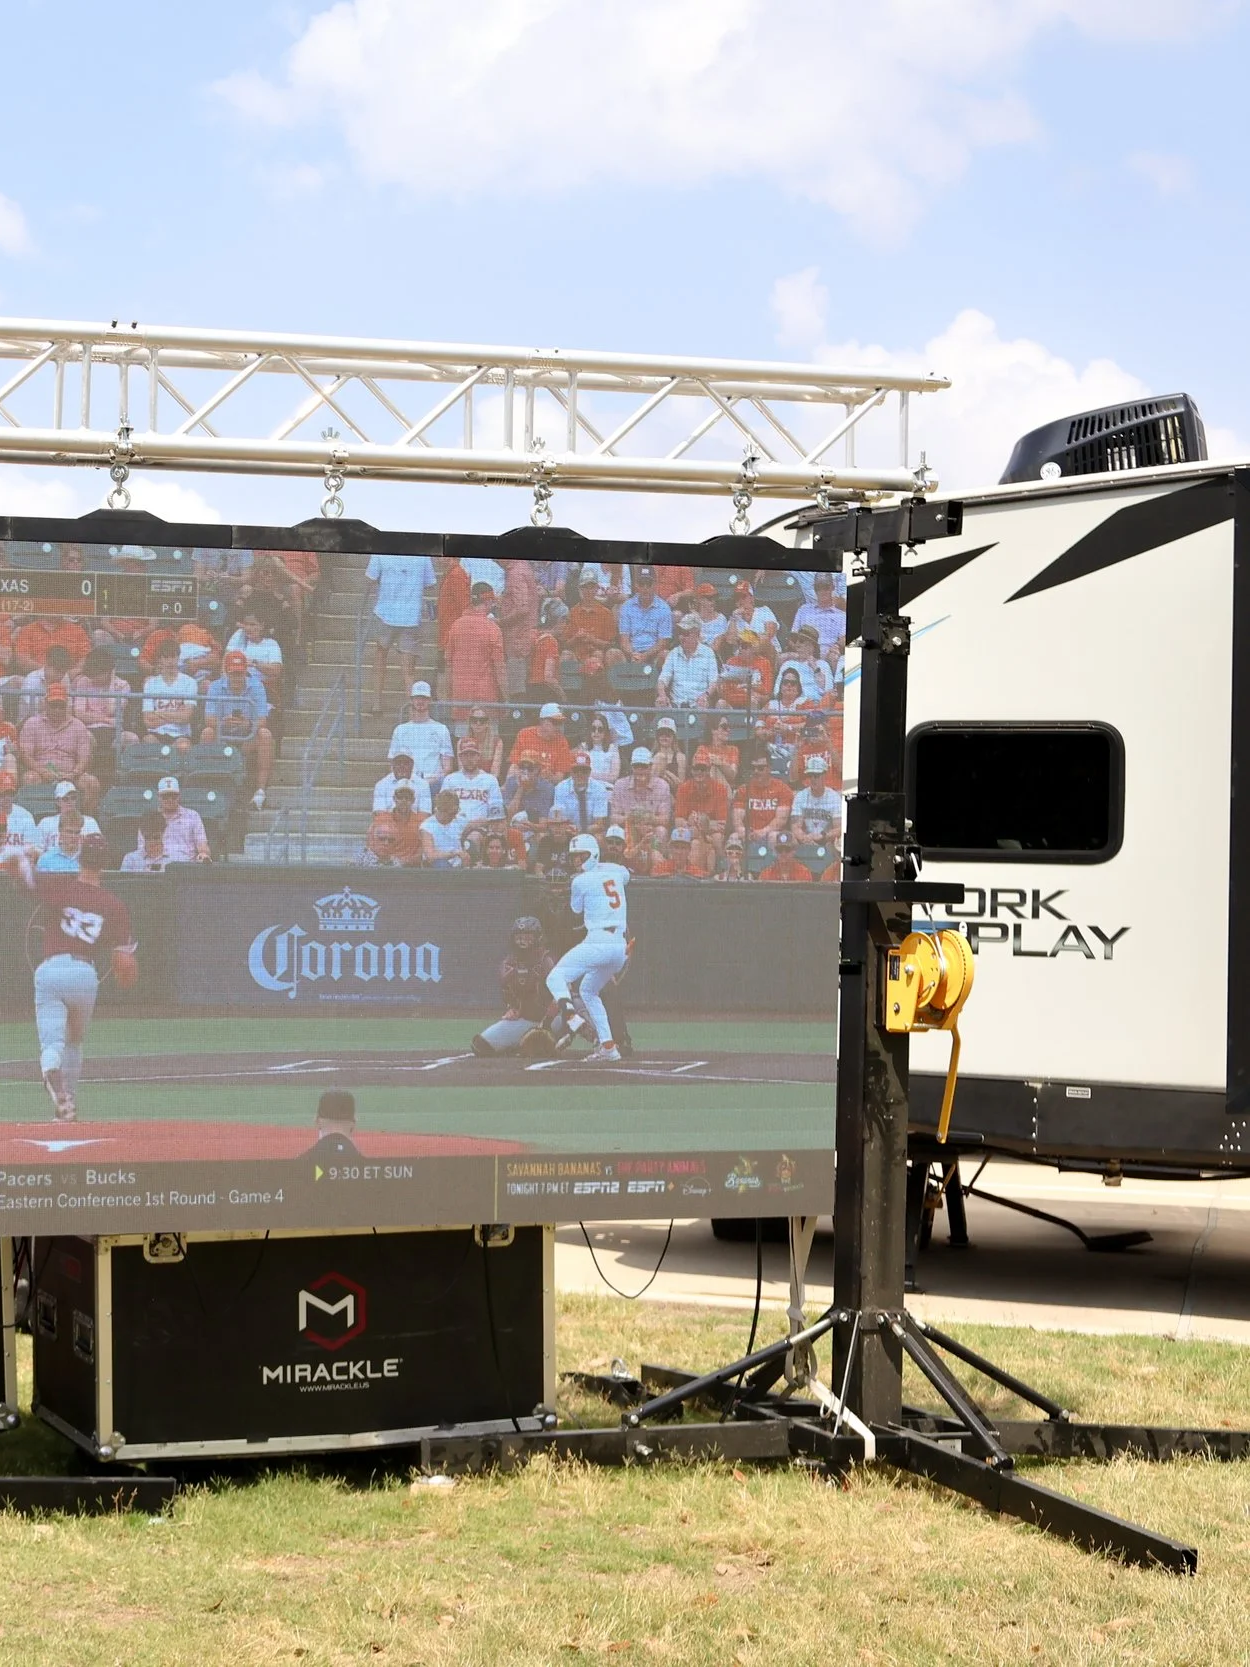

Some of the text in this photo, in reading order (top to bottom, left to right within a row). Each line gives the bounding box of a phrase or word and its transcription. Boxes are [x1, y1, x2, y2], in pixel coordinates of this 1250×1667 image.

[81, 580, 91, 595] 0
[151, 580, 193, 593] ESPN
[174, 602, 182, 614] 0
[603, 879, 621, 909] 5
[922, 888, 1071, 921] ORK
[964, 922, 1132, 960] PLAY
[248, 923, 442, 1000] Corona
[86, 1169, 136, 1185] Bucks
[328, 1165, 413, 1181] 9:30 ET SUN
[506, 1163, 555, 1177] SAVANNAH
[557, 1162, 602, 1176] BANANAS
[506, 1183, 539, 1195] TONIGHT
[57, 1193, 141, 1208] Conference
[144, 1191, 165, 1207] 1st
[169, 1190, 216, 1205] Round
[228, 1189, 271, 1205] Game
[274, 1188, 284, 1203] 4
[262, 1358, 399, 1385] MIRACKLE
[299, 1381, 370, 1393] WWW.MIRACKLE.US
